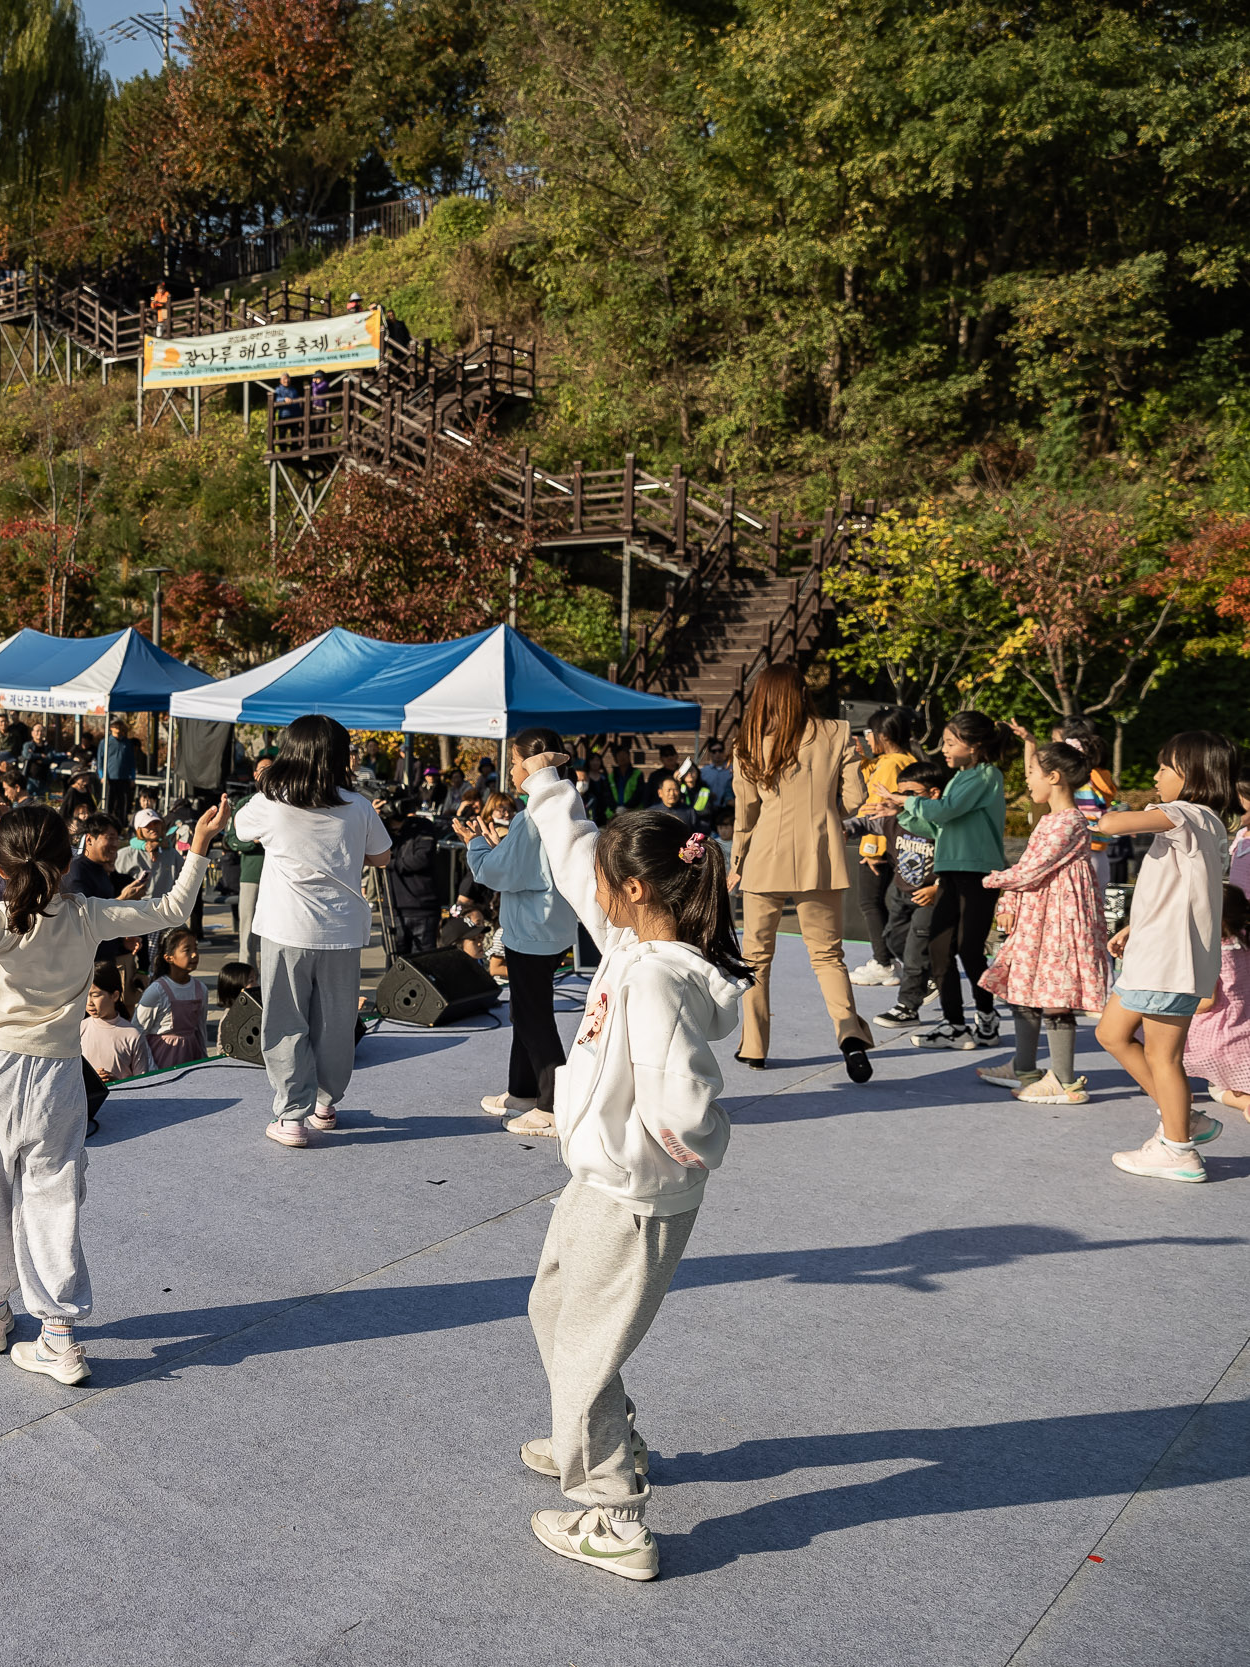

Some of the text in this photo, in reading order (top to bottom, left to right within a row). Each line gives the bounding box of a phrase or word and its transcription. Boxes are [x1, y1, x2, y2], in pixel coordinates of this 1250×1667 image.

[184, 345, 235, 367] 광나루
[239, 338, 291, 361] 해오름
[294, 333, 330, 356] 축제
